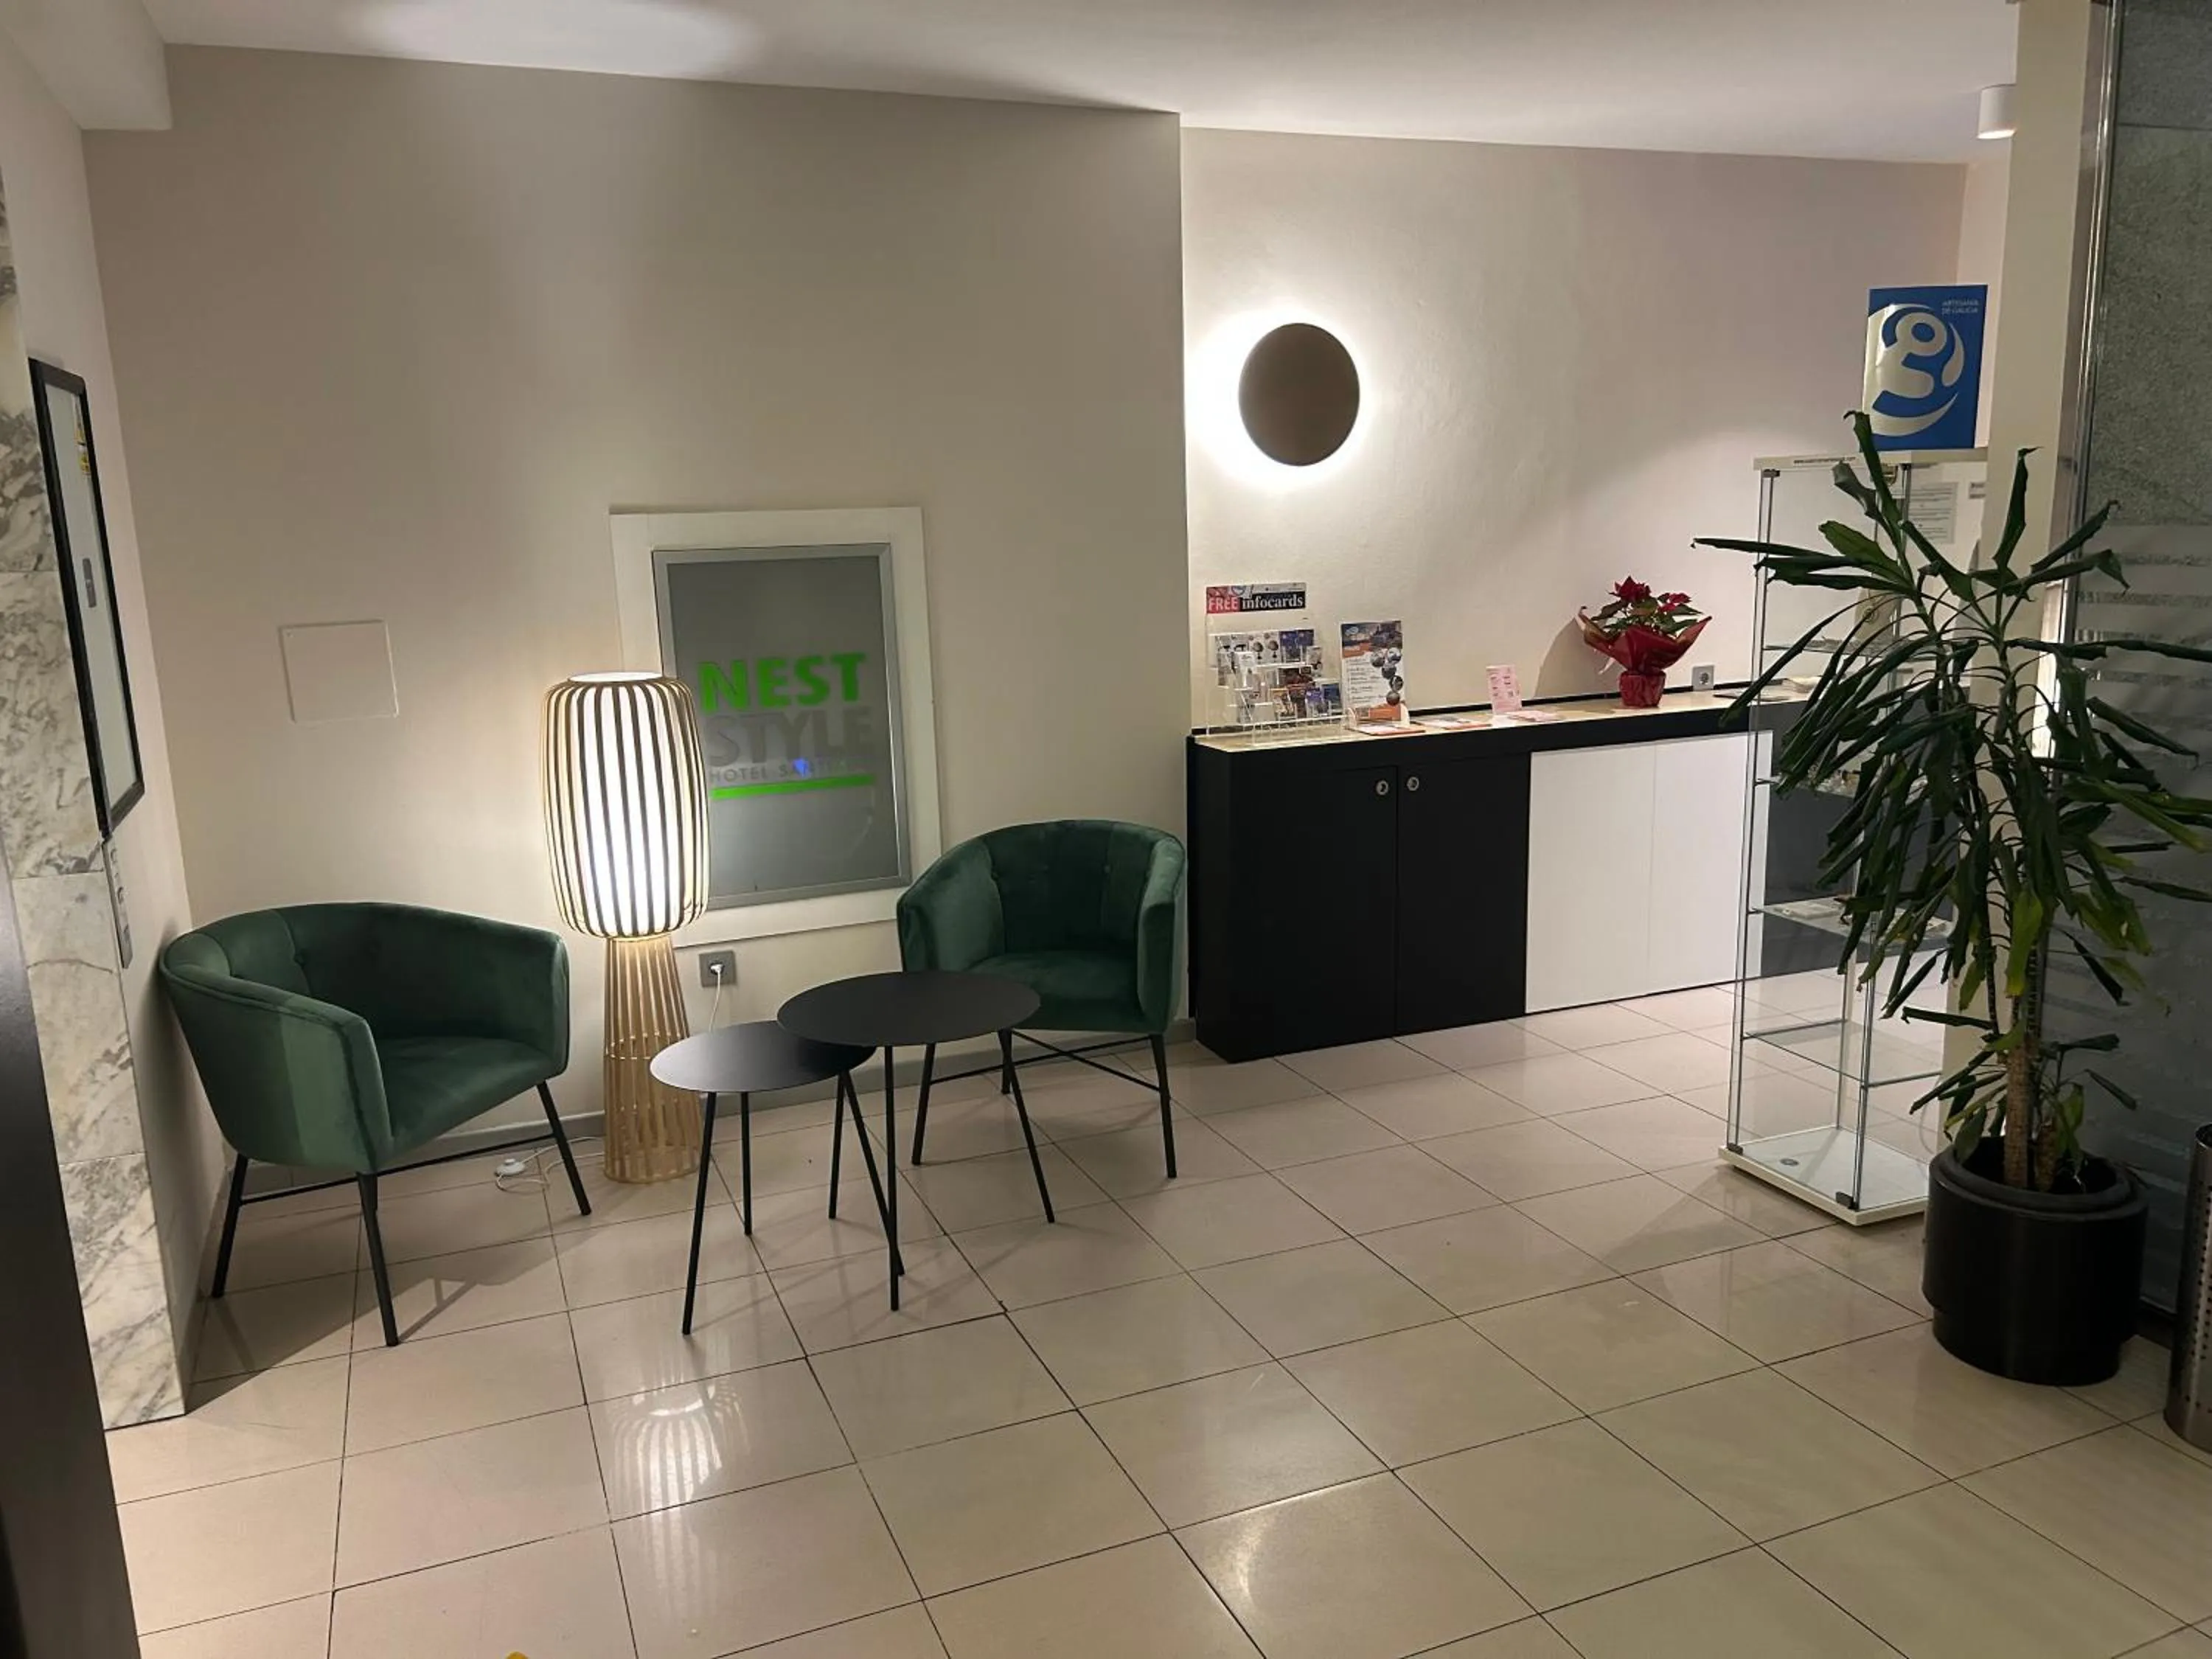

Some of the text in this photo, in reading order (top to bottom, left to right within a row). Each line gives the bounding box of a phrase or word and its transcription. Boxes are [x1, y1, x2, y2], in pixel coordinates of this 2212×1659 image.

[1208, 593, 1304, 611] FREE infocards
[699, 652, 866, 714] NEST
[706, 706, 874, 767] STYLE
[709, 766, 768, 783] HOTEL
